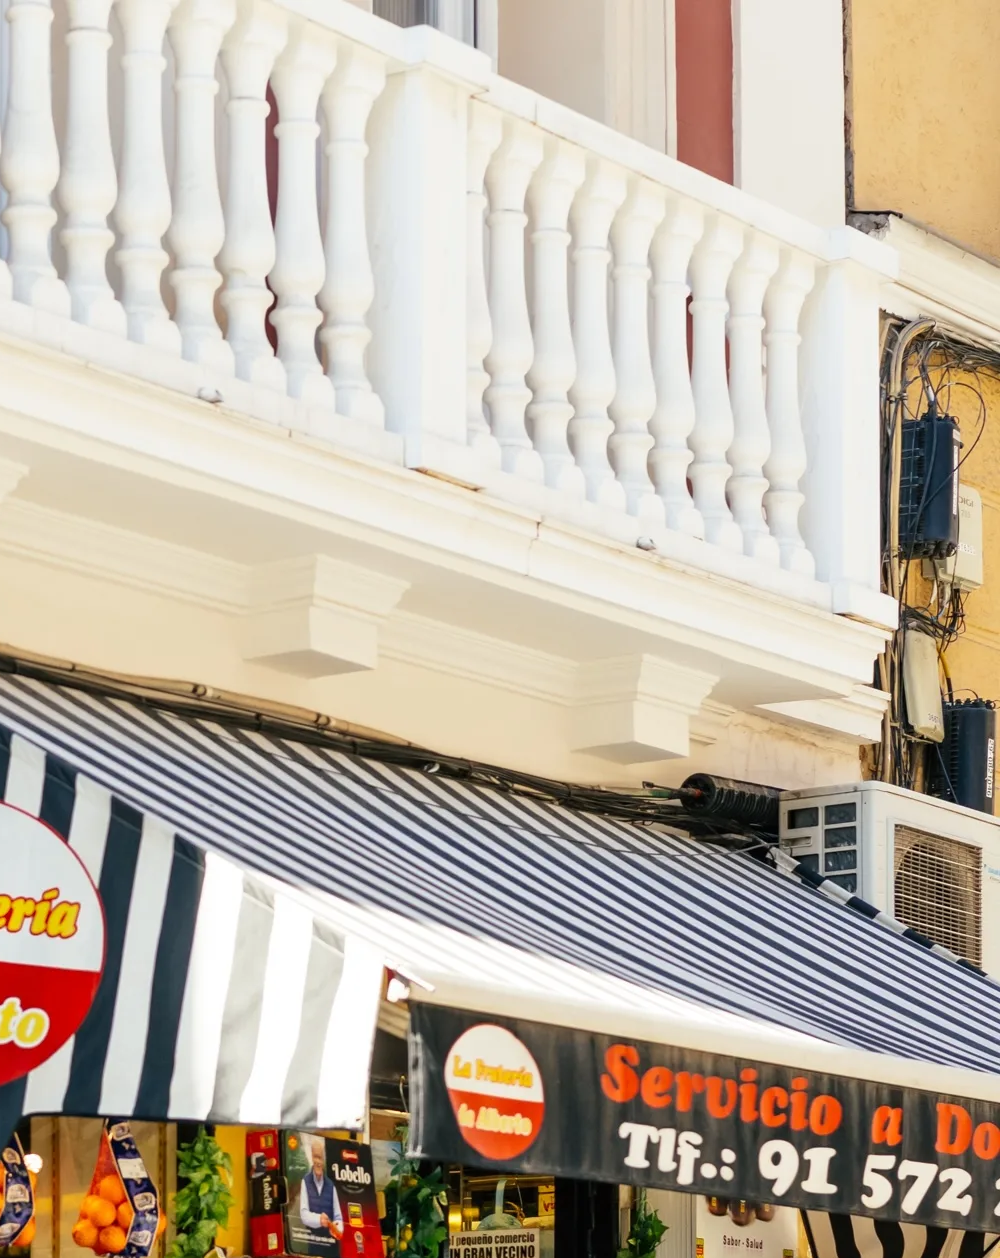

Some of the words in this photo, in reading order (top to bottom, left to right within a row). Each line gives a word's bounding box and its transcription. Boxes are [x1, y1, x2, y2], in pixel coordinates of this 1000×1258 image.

[600, 1043, 843, 1135] Servicio
[872, 1105, 903, 1146] a
[332, 1163, 372, 1185] Lobello
[618, 1122, 736, 1186] Tlf.:
[758, 1139, 838, 1197] 91
[861, 1155, 973, 1217] 572
[456, 1234, 493, 1247] pequeño
[494, 1232, 535, 1245] comercio
[722, 1235, 741, 1247] Sabor
[746, 1238, 763, 1250] Salud
